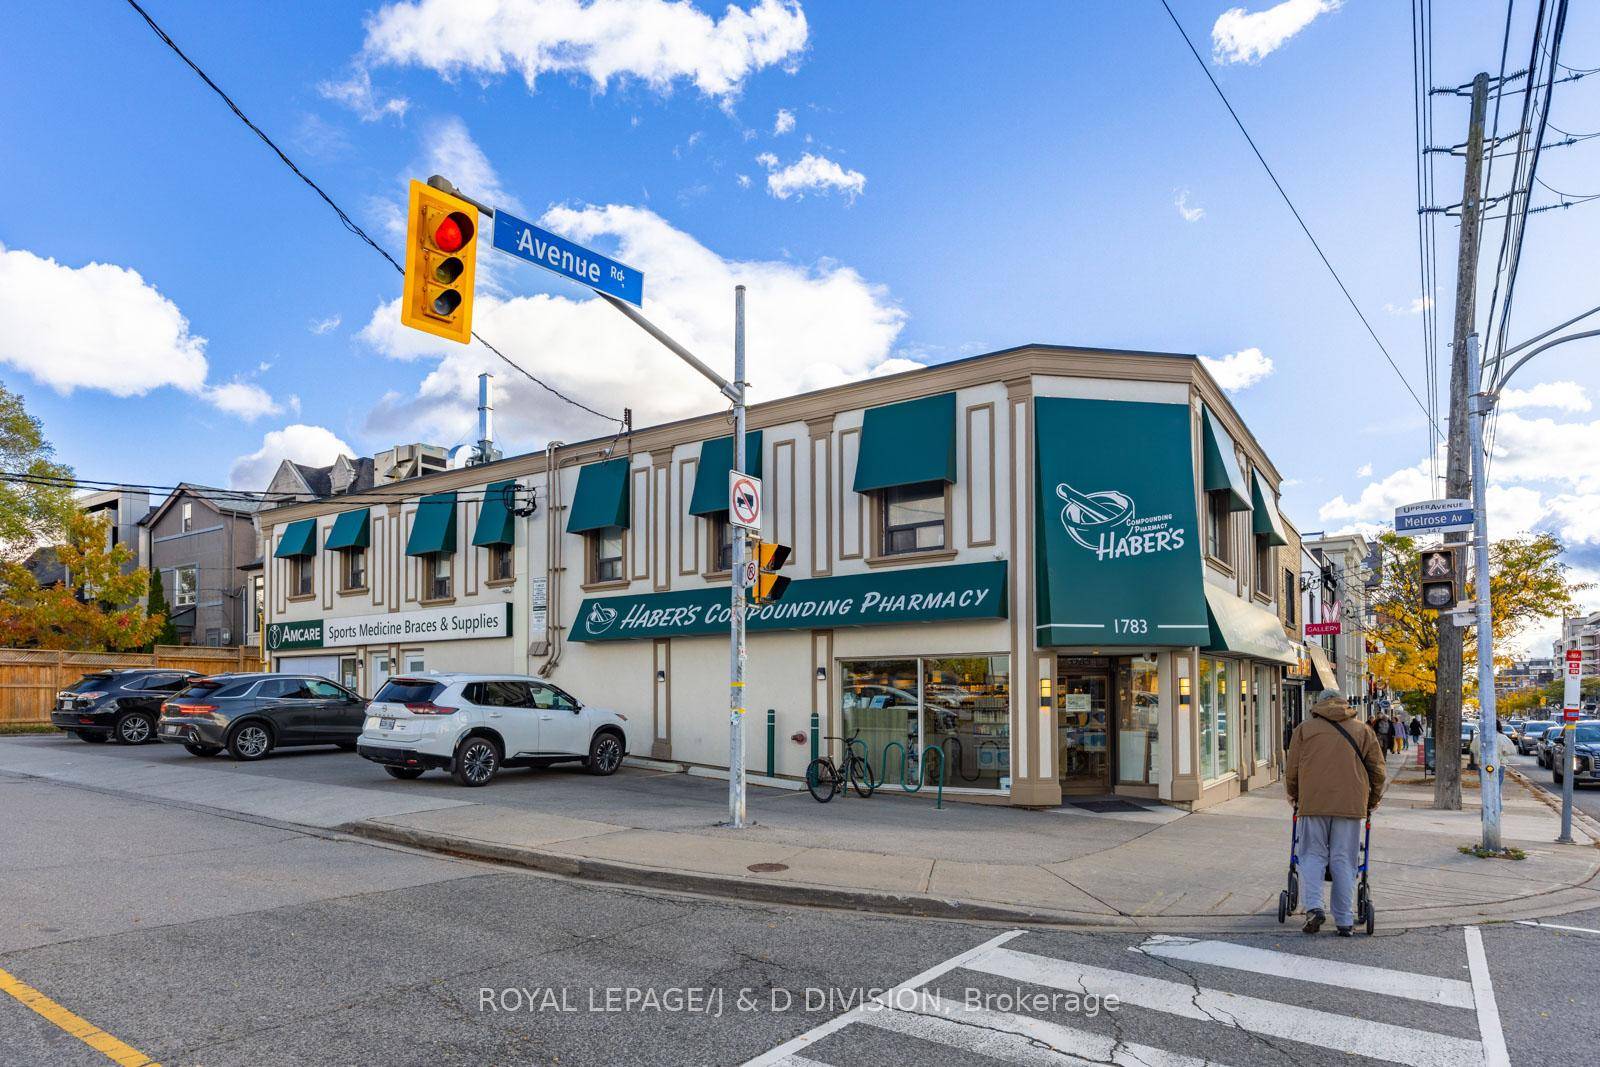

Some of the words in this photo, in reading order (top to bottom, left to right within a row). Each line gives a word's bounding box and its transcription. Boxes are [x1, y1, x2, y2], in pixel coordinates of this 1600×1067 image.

[517, 228, 601, 283] Avenue
[610, 264, 624, 282] Rd
[1126, 513, 1173, 526] COMPOUNDING
[1134, 522, 1168, 533] PHARMACY
[1405, 515, 1447, 527] Melrose
[1452, 514, 1462, 522] Av
[1096, 527, 1185, 561] HABER'S
[619, 602, 702, 630] HABER'S
[704, 598, 854, 624] COPOUNDING
[860, 588, 989, 613] PHARMACY
[281, 625, 321, 643] AMCARE
[328, 625, 357, 642] Sports
[359, 620, 402, 637] Medicine
[404, 619, 437, 634] Braces
[440, 616, 449, 631] &
[451, 613, 499, 634] Supplies
[1114, 619, 1148, 634] 1783
